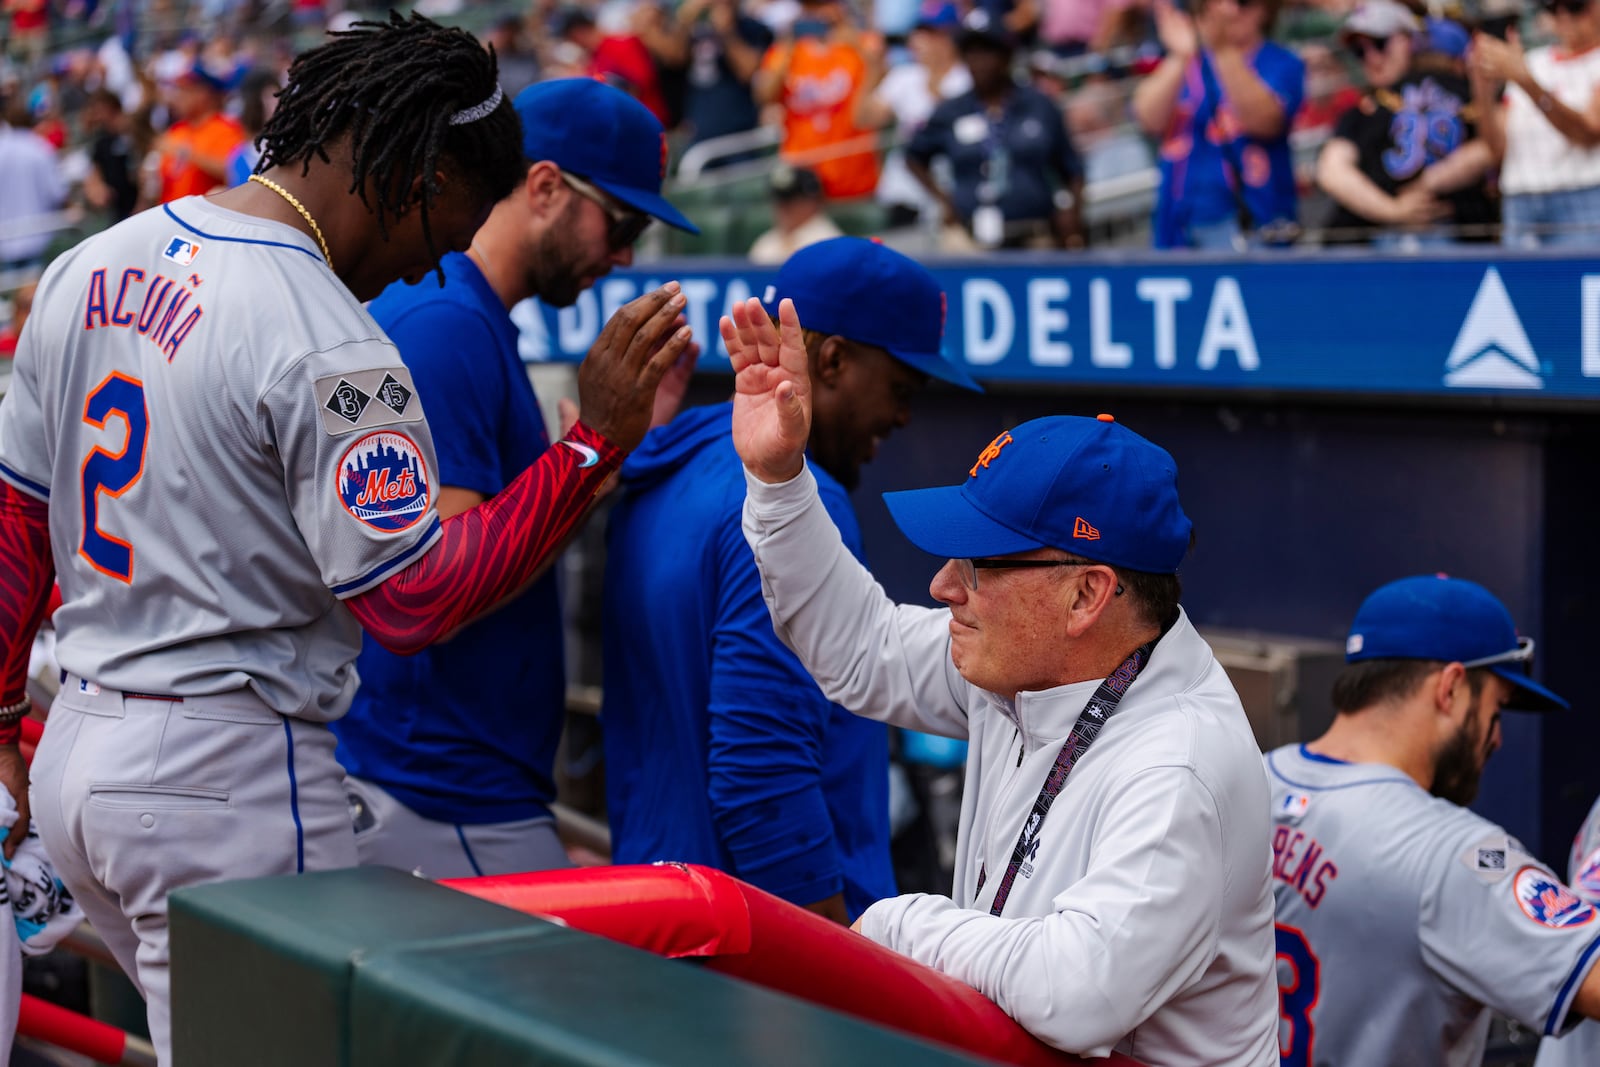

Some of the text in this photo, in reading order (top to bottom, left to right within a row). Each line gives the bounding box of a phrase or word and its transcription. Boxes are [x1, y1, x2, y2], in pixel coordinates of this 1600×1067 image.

[85, 268, 204, 364] ACUÑA
[962, 276, 1260, 371] DELTA
[336, 385, 361, 418] 3
[78, 369, 150, 585] 2
[356, 468, 416, 507] Mets
